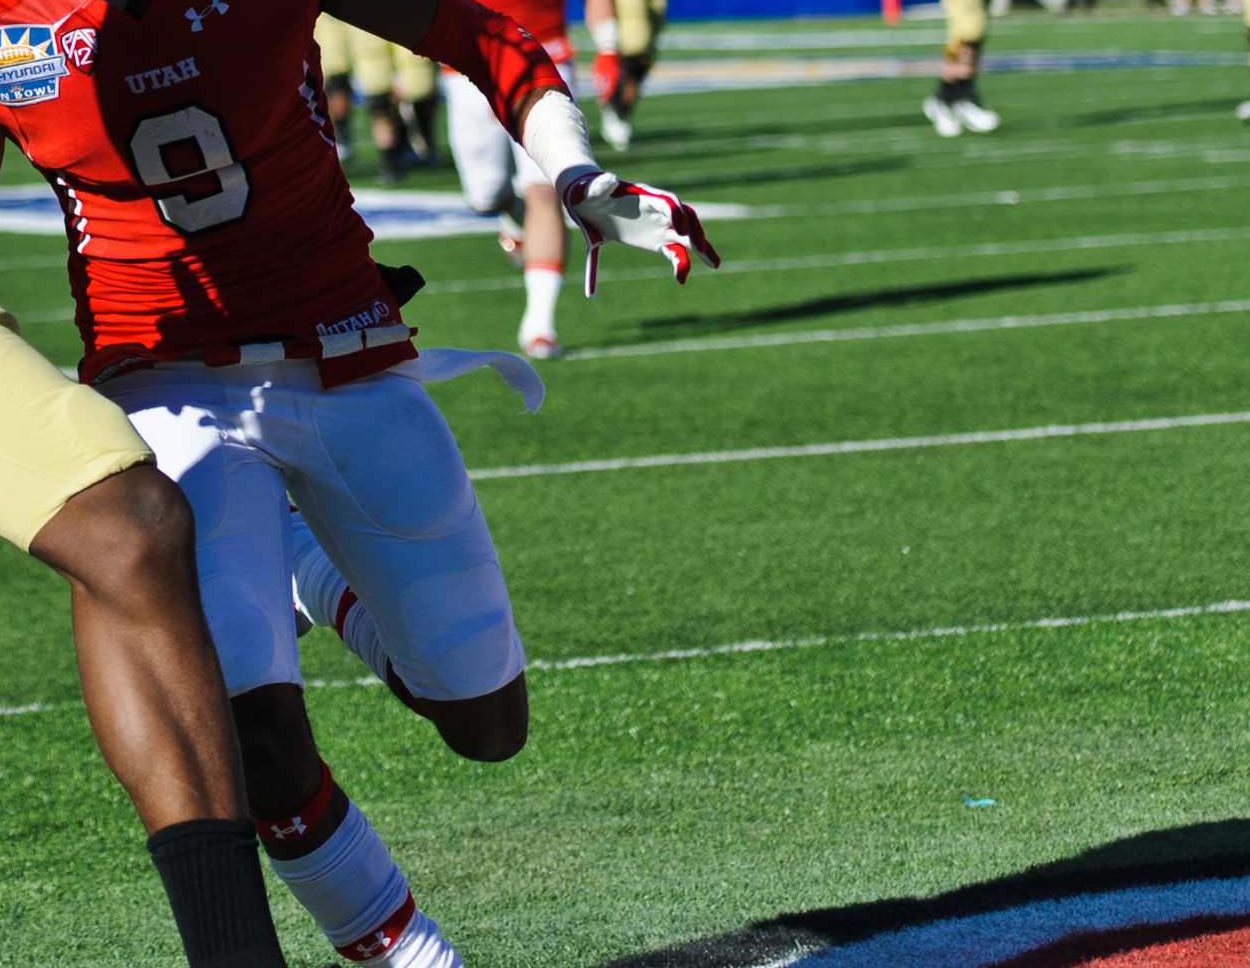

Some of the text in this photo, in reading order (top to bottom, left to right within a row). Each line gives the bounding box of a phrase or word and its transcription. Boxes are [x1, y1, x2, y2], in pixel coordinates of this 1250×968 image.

[62, 28, 98, 59] PAC
[73, 46, 95, 67] 12
[124, 57, 200, 94] UTAH
[14, 84, 55, 99] BOWL
[126, 101, 252, 235] 9
